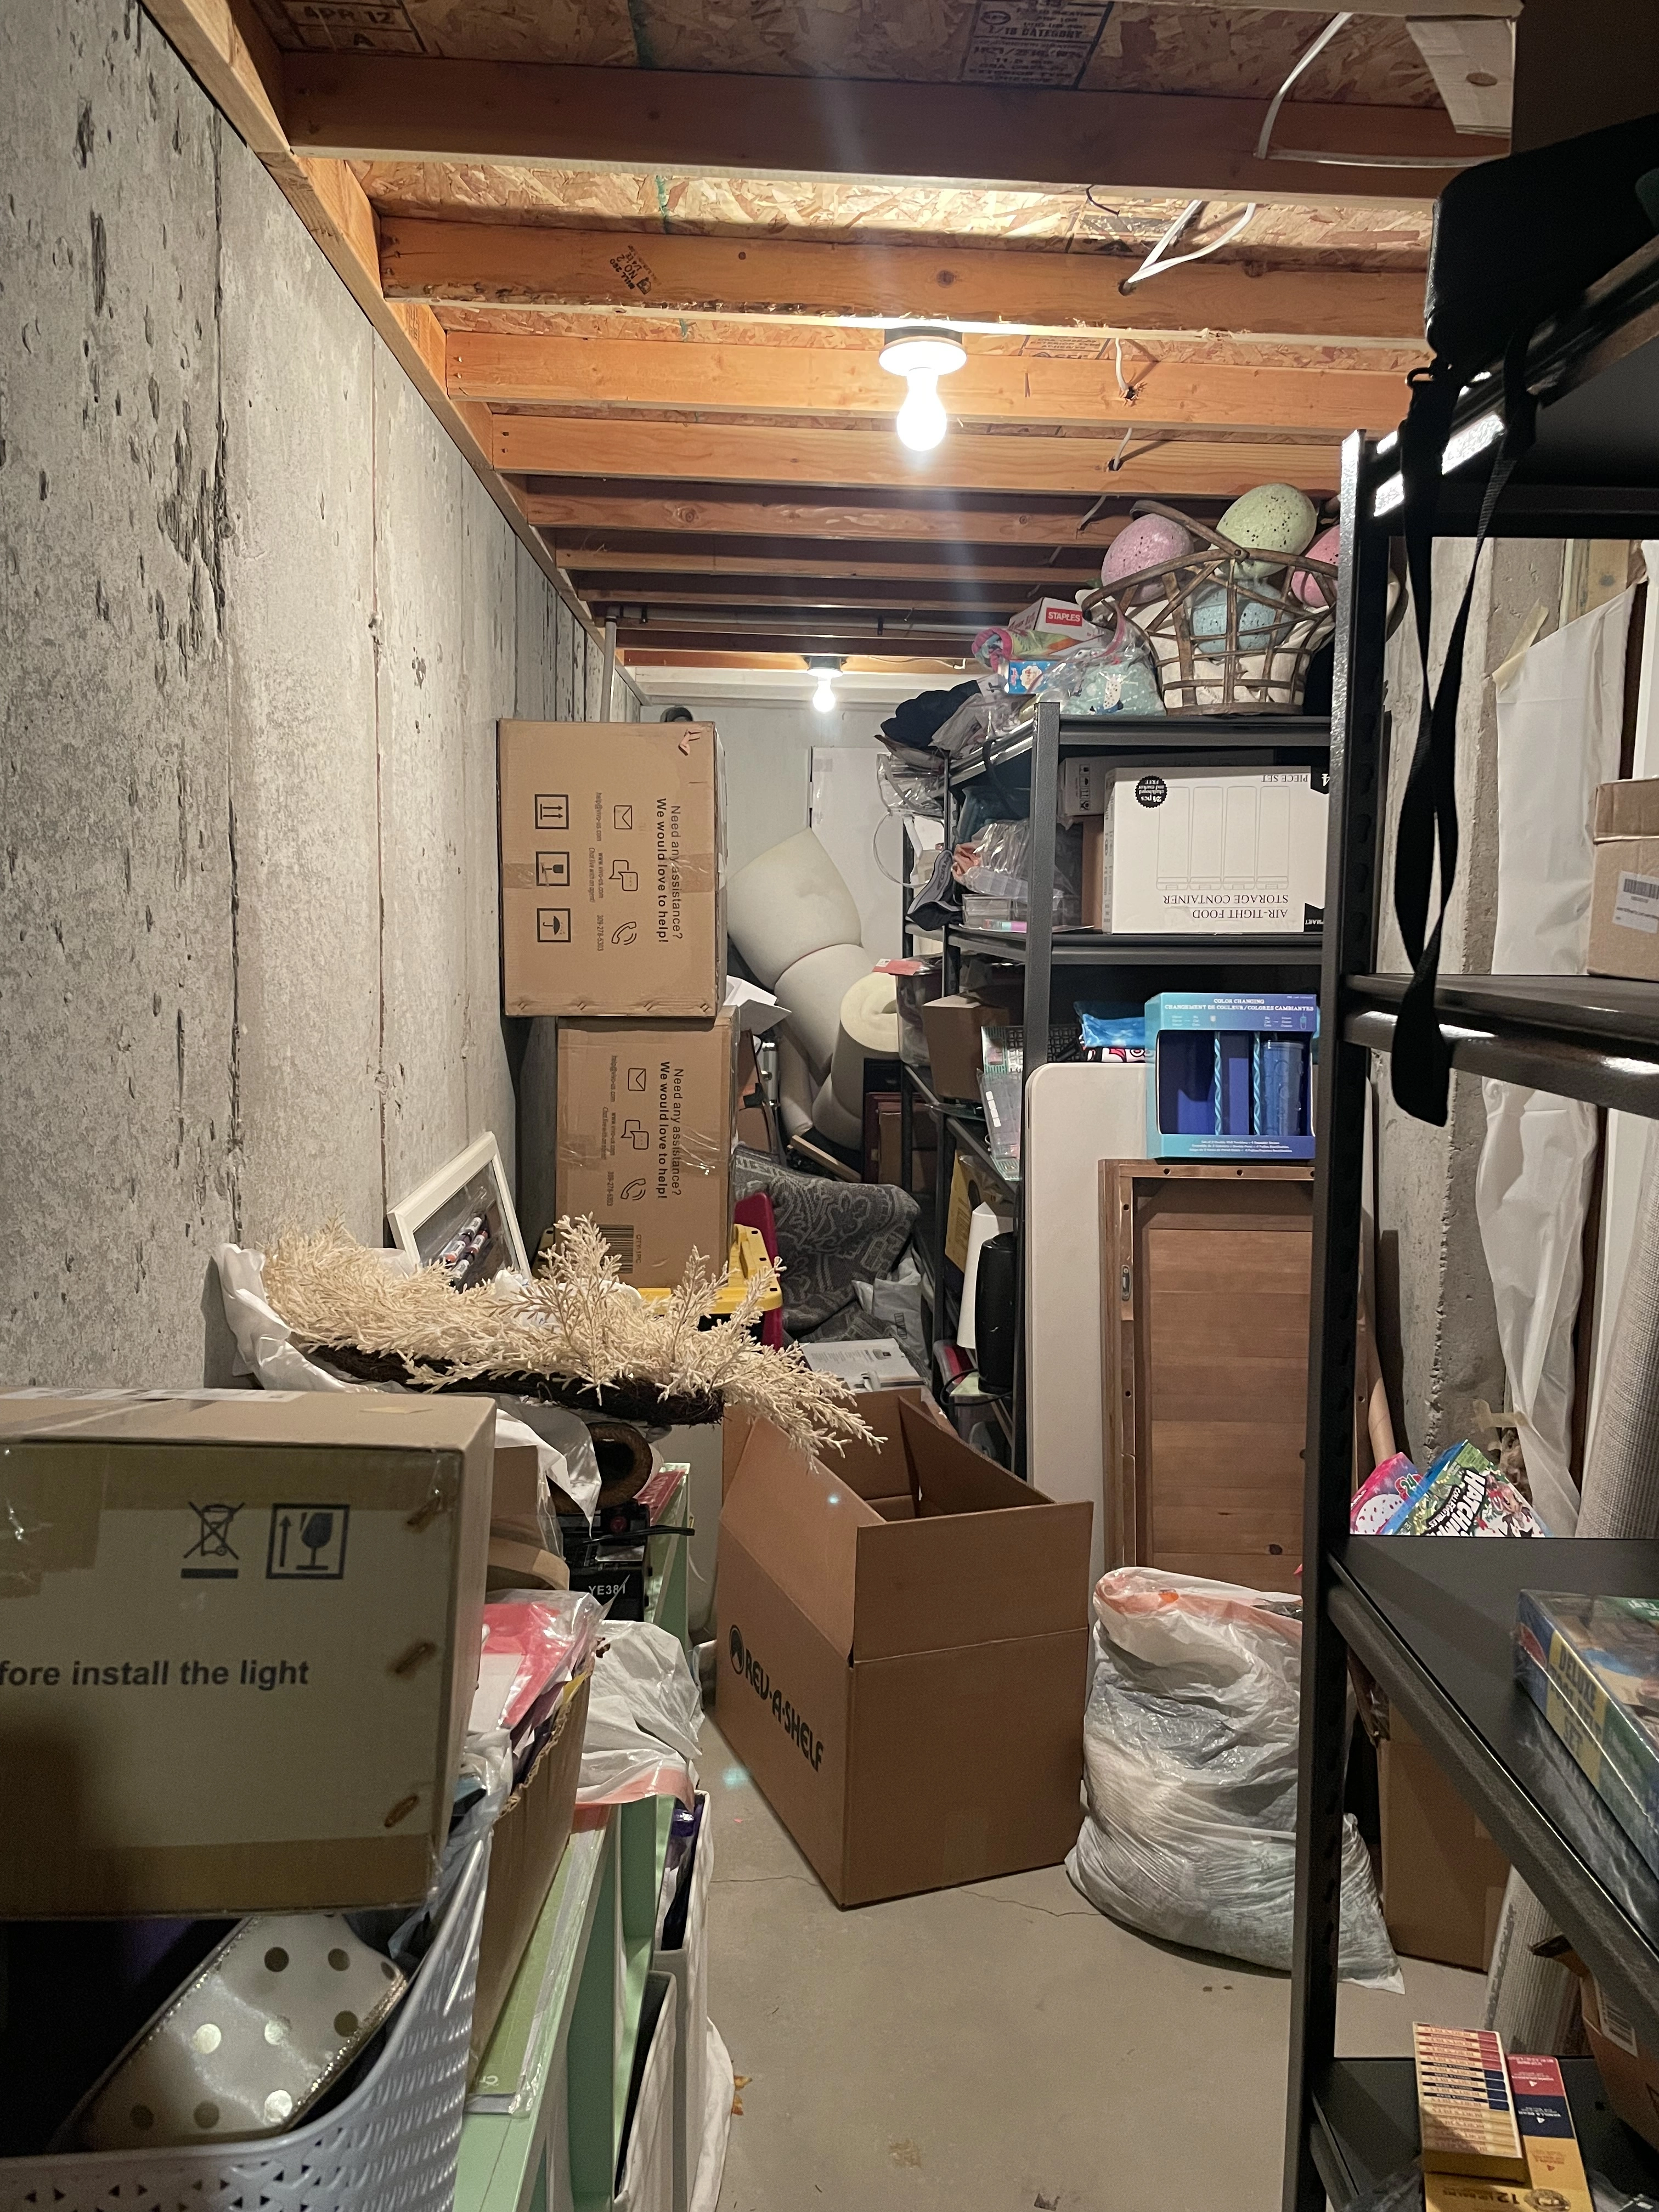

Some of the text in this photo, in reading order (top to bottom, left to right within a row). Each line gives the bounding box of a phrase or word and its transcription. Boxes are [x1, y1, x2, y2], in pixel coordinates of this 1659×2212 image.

[1022, 28, 1082, 38] CATEGORY
[1048, 611, 1081, 622] STAPLES
[1282, 774, 1308, 782] PIECE
[1321, 773, 1330, 787] 4
[657, 798, 668, 943] We would love to help!
[670, 805, 683, 939] Need any assistance?
[1163, 895, 1289, 904] STORAGE CONTAINER
[1192, 909, 1288, 918] AIR-TIGHT FOOD
[656, 1062, 670, 1198] We would love to help!
[670, 1069, 684, 1195] Need any assistance?
[1401, 1474, 1417, 1490] 24
[1426, 1470, 1486, 1536] HATCHIM
[72, 1660, 168, 1686] install
[180, 1660, 229, 1685] the
[239, 1660, 309, 1691] light
[1497, 2193, 1520, 2204] 12
